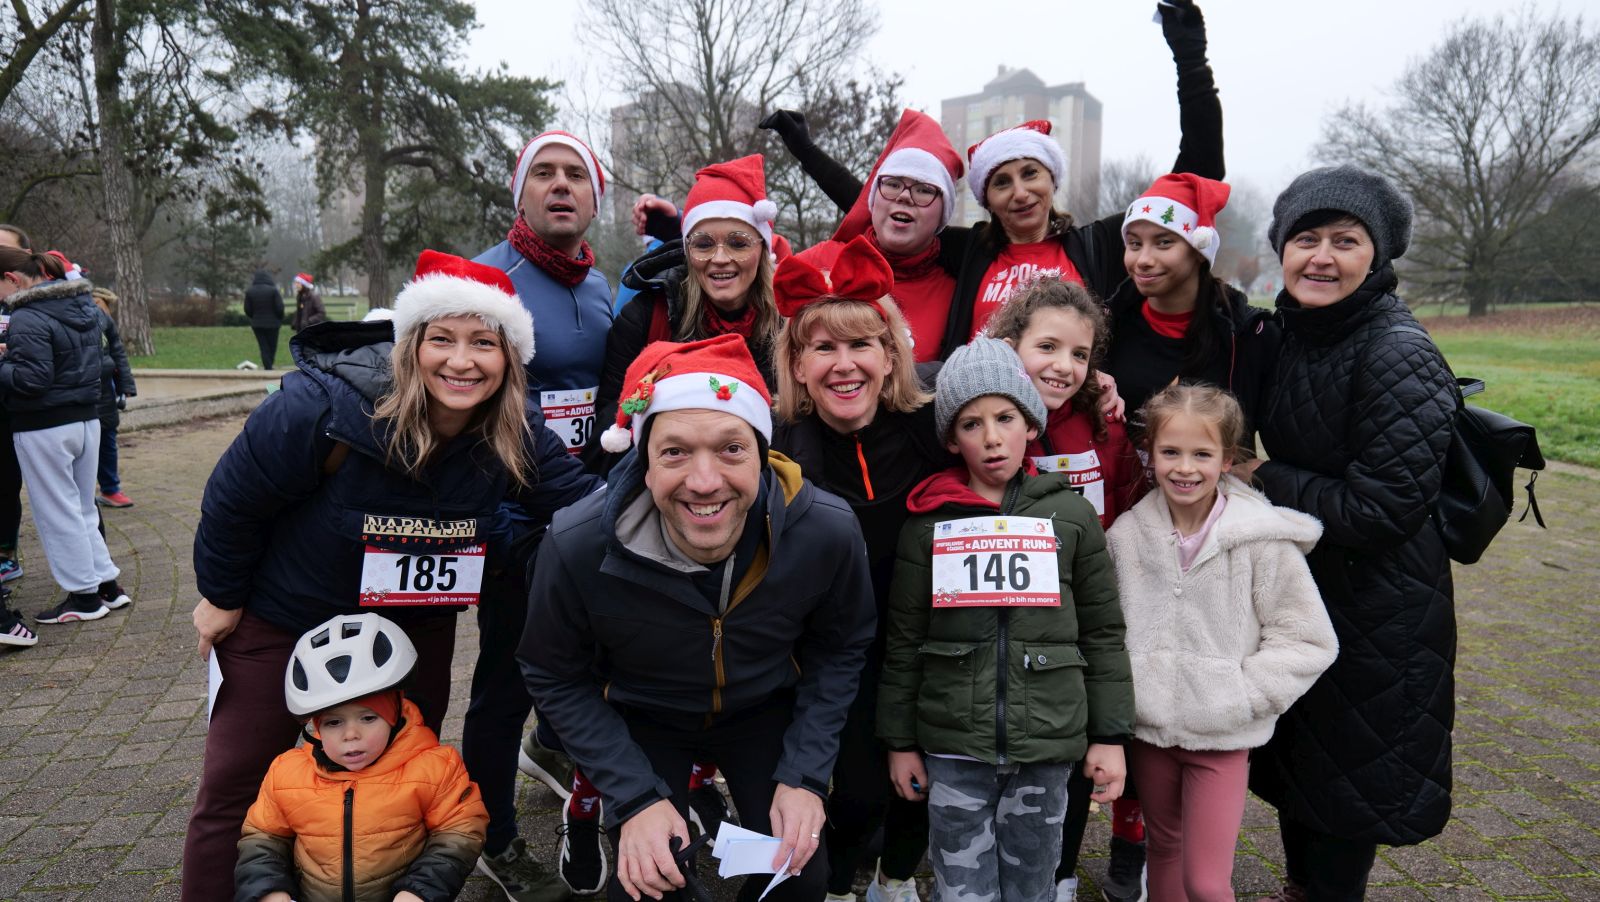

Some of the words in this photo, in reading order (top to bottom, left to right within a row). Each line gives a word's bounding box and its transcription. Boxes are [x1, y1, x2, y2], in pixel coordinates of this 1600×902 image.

[982, 282, 1012, 302] MA
[566, 406, 594, 416] «ADVEN
[965, 538, 1020, 550] «ADVENT
[1023, 538, 1053, 549] RUN»
[396, 555, 458, 591] 185
[963, 553, 1031, 591] 146
